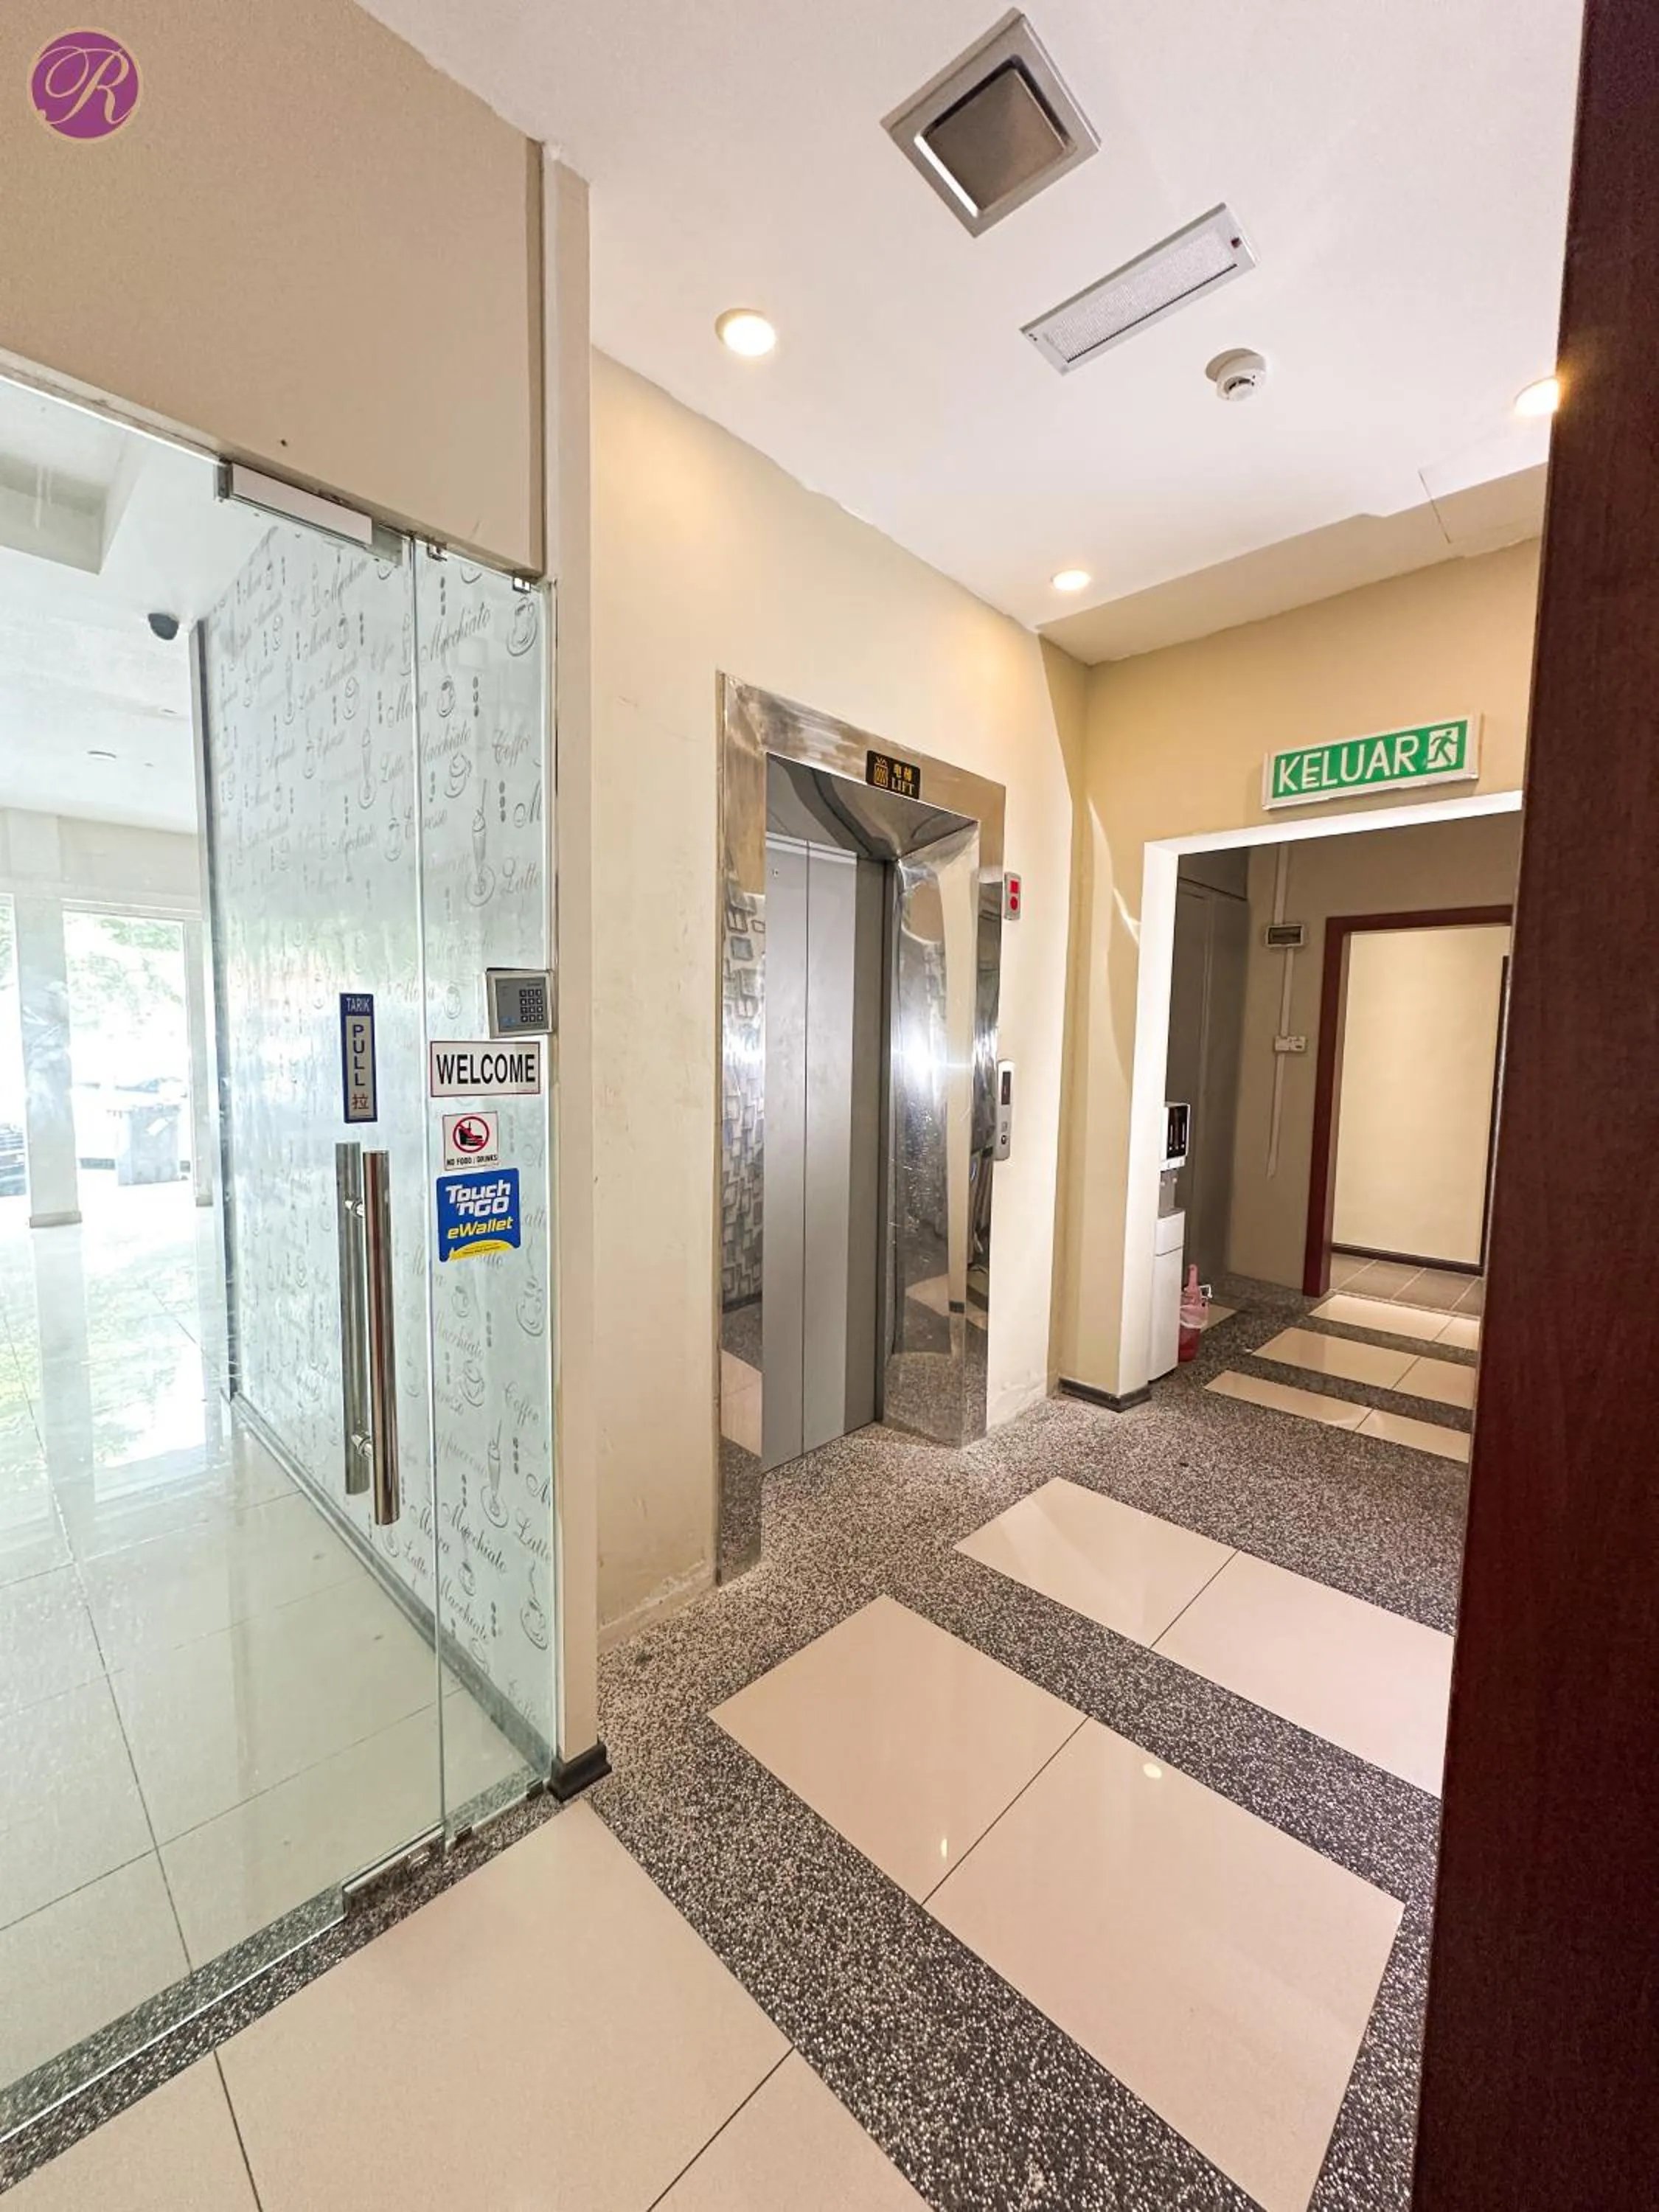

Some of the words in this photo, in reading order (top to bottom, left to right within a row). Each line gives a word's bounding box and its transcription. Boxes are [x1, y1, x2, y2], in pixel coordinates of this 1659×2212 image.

[1278, 736, 1419, 793] KELUAR
[891, 776, 915, 795] LIFT
[346, 998, 370, 1012] TARIK
[352, 1024, 366, 1086] PULL
[436, 1054, 536, 1085] WELCOME
[351, 1093, 369, 1110] 拉
[447, 1158, 455, 1166] NO
[456, 1156, 472, 1165] FOOD
[476, 1154, 498, 1163] DRINKS
[445, 1180, 511, 1204] Touch
[447, 1217, 514, 1239] eWallet
